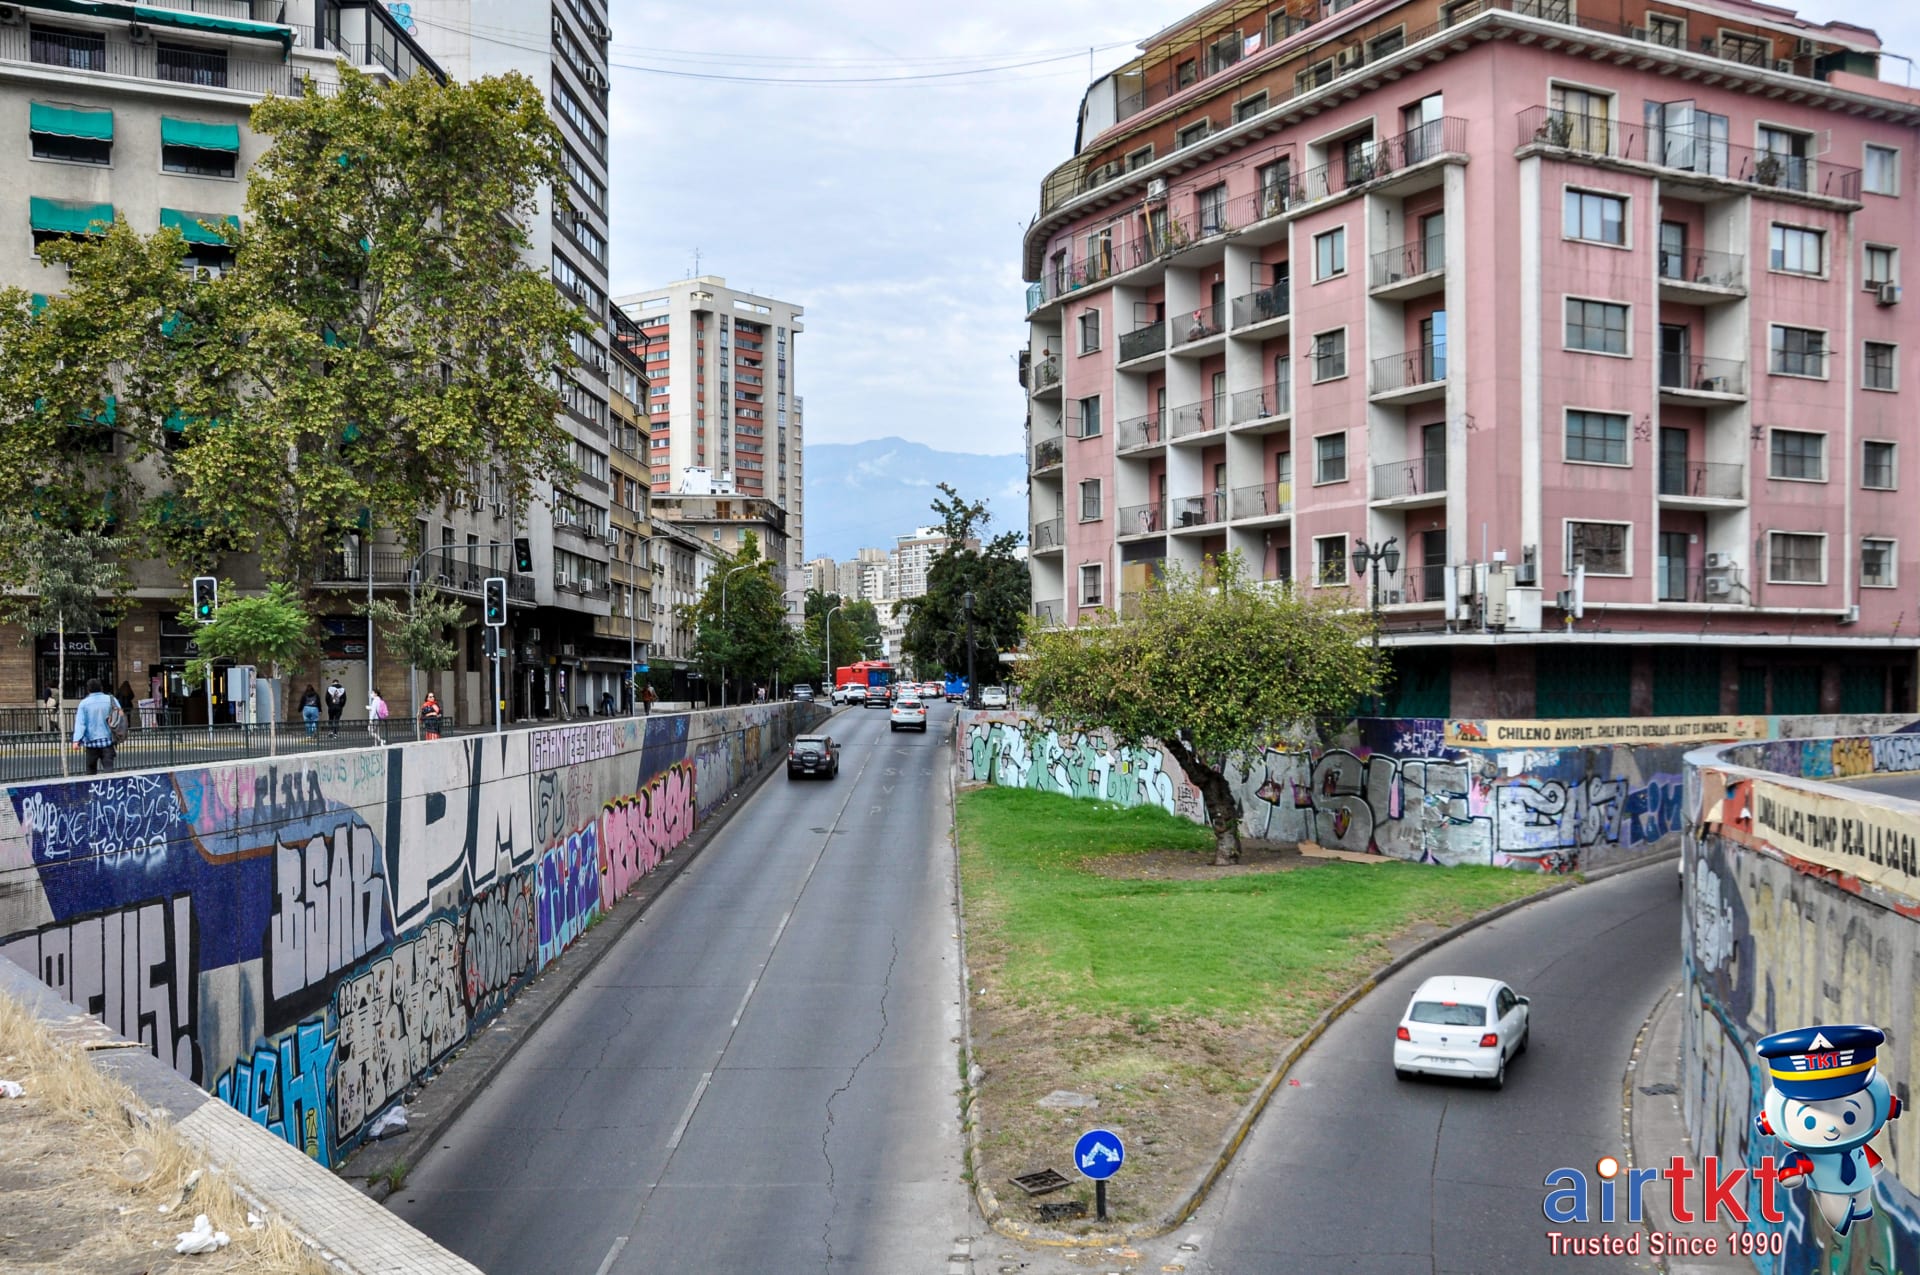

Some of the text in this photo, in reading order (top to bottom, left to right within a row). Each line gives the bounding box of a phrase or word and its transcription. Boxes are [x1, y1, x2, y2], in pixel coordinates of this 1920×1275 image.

[1498, 726, 1551, 740] CHILENO
[1842, 818, 1865, 856] DEJA
[1869, 824, 1883, 865] LA
